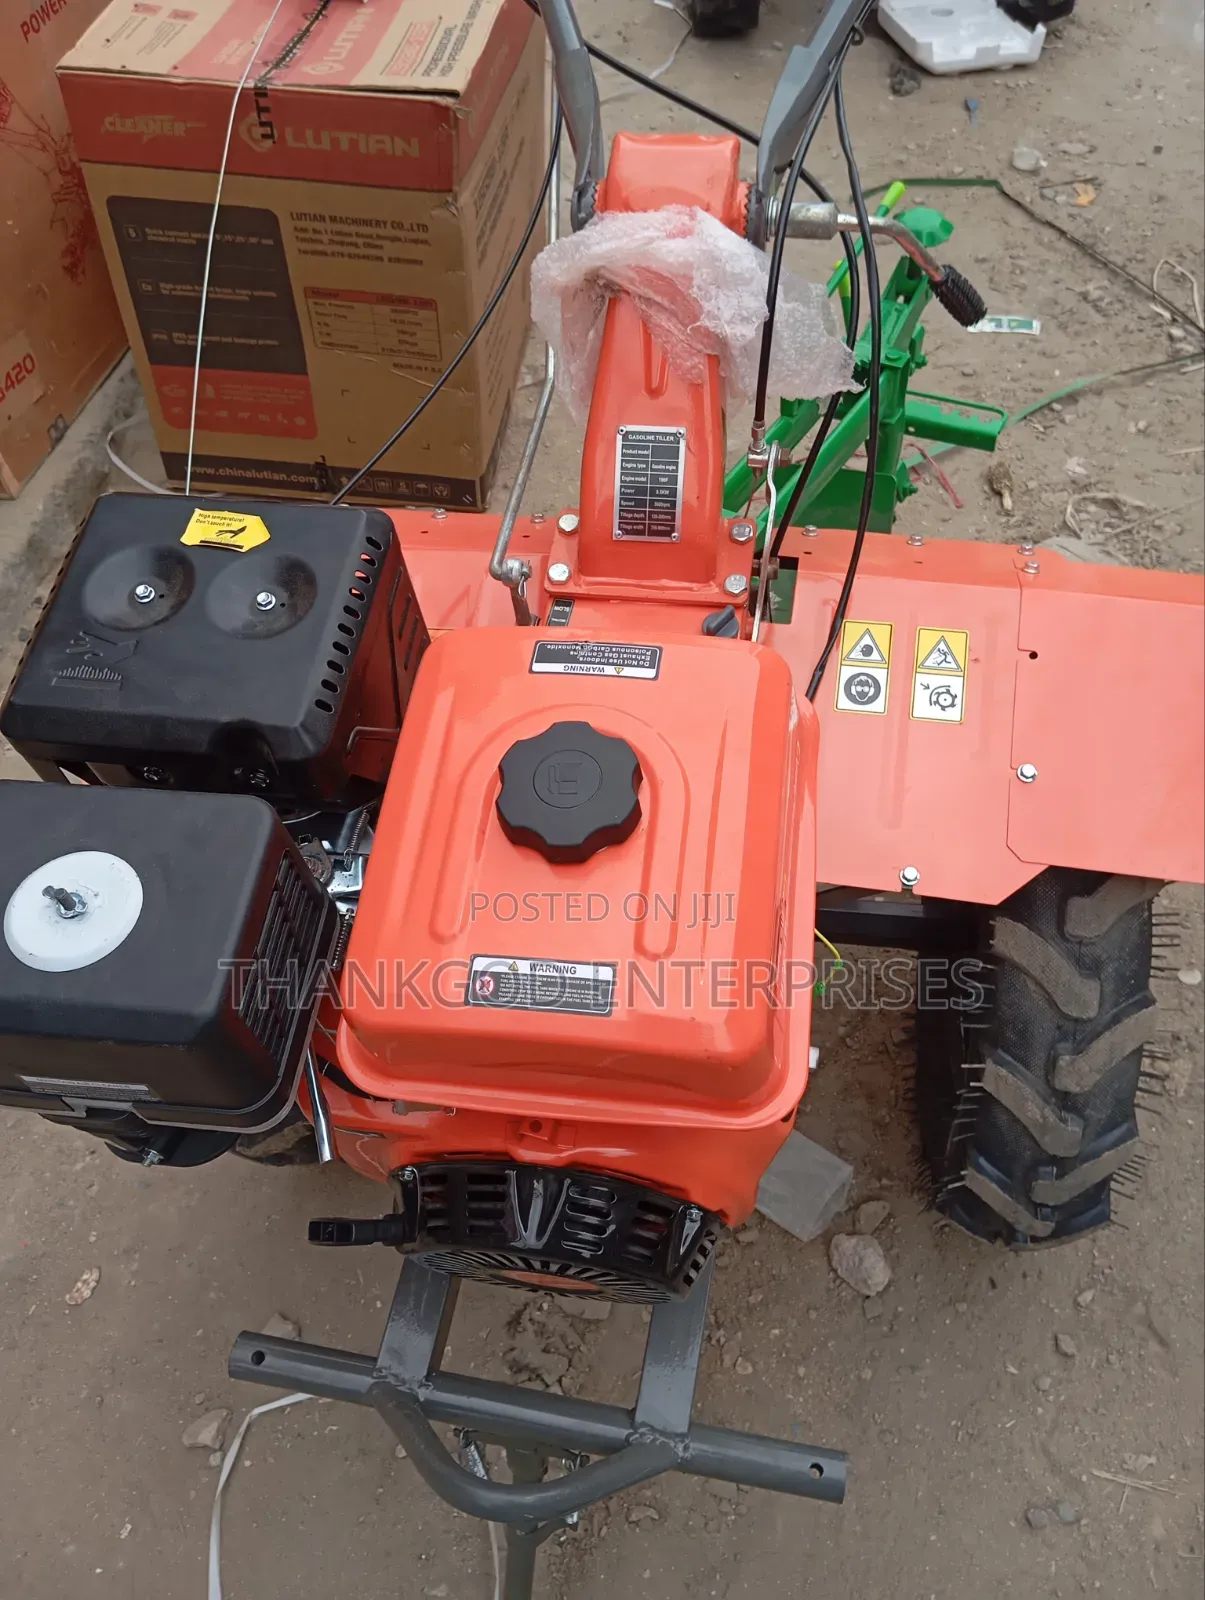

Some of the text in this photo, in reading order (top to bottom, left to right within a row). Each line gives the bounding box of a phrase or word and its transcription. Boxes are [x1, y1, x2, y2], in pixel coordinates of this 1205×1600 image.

[285, 127, 420, 158] LUTIAN
[290, 211, 327, 224] LUTIAN
[328, 214, 389, 230] MACHINERY
[612, 647, 652, 655] Poisonous
[630, 653, 651, 661] Exhaust
[624, 659, 639, 667] Not
[563, 664, 605, 674] WARNING
[529, 961, 578, 976] WARNING
